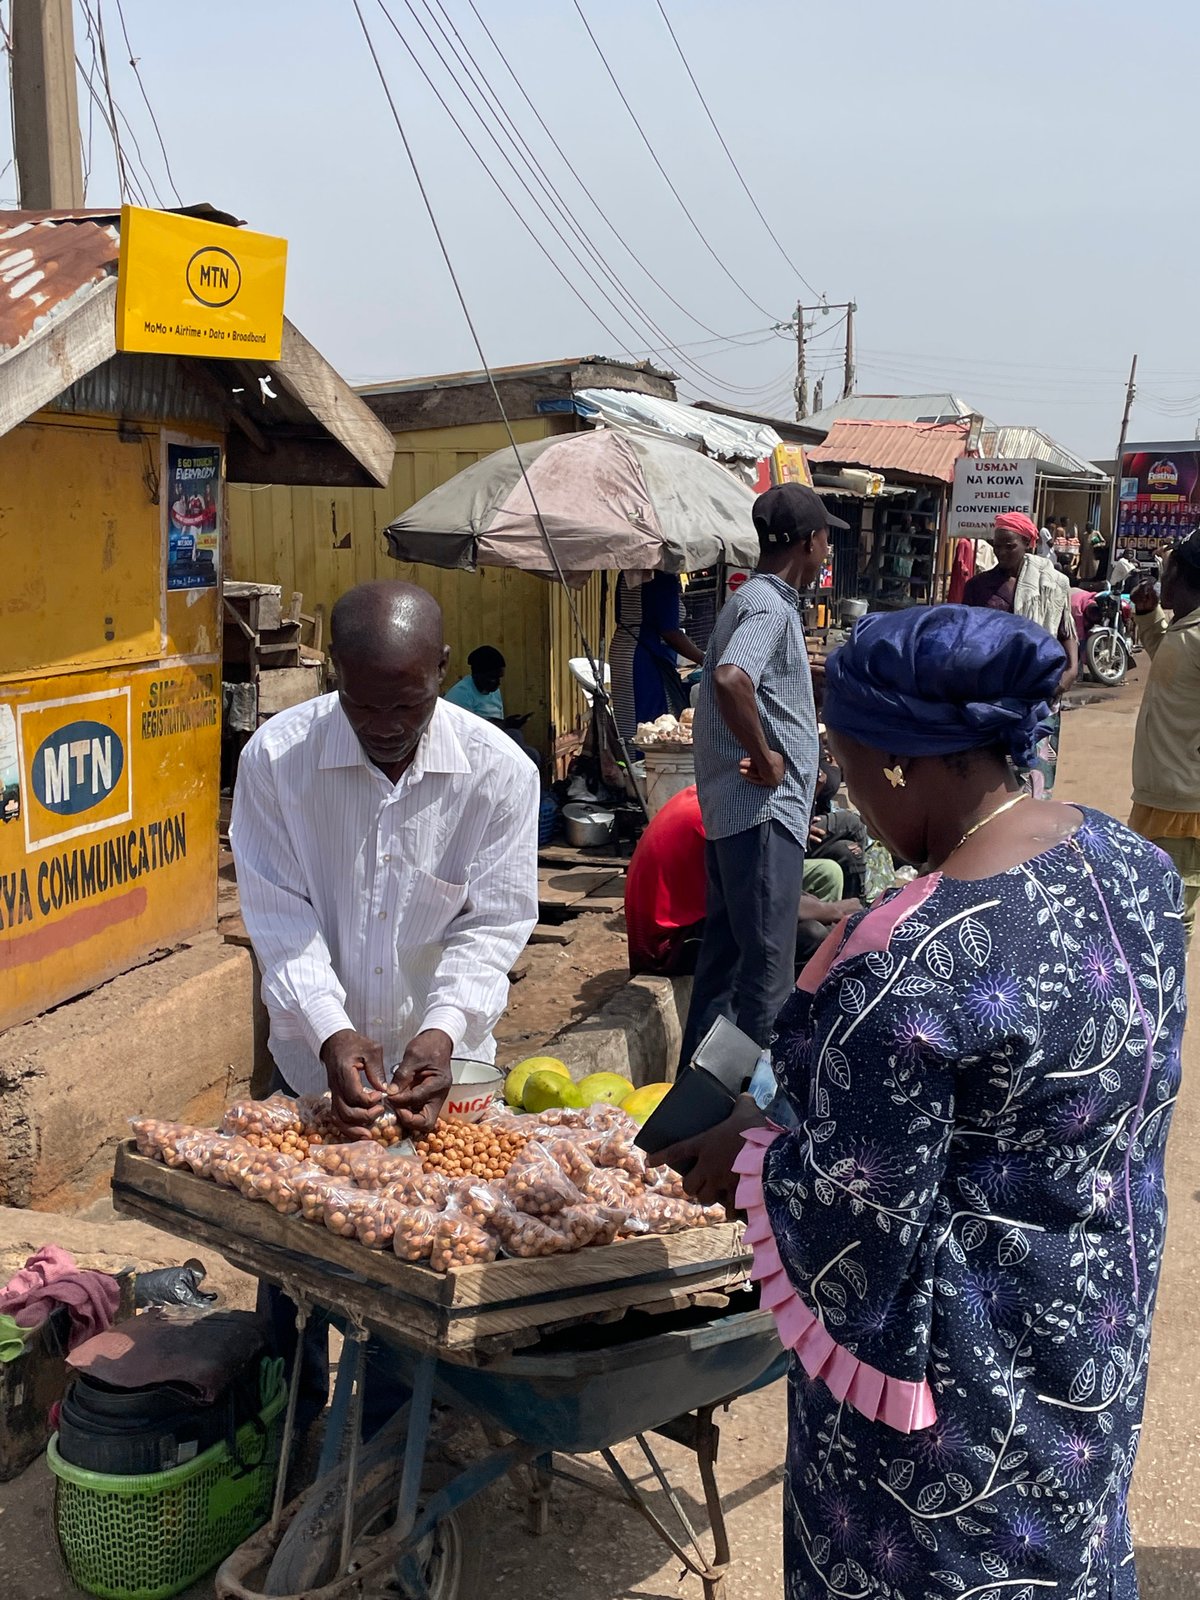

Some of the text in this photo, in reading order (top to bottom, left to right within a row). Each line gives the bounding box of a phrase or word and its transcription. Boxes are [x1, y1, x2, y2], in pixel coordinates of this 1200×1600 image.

[200, 265, 229, 289] MTN
[144, 321, 266, 343] MoMo Airtime Data Broadband
[176, 467, 216, 479] EVERYBODY
[975, 463, 1018, 471] USMAN
[967, 475, 1024, 485] NA KOWA
[975, 491, 1010, 499] PUBLIC
[956, 505, 1029, 513] CONVENIENCE
[44, 735, 112, 804] MTN
[37, 812, 187, 916] COMMUNICATION
